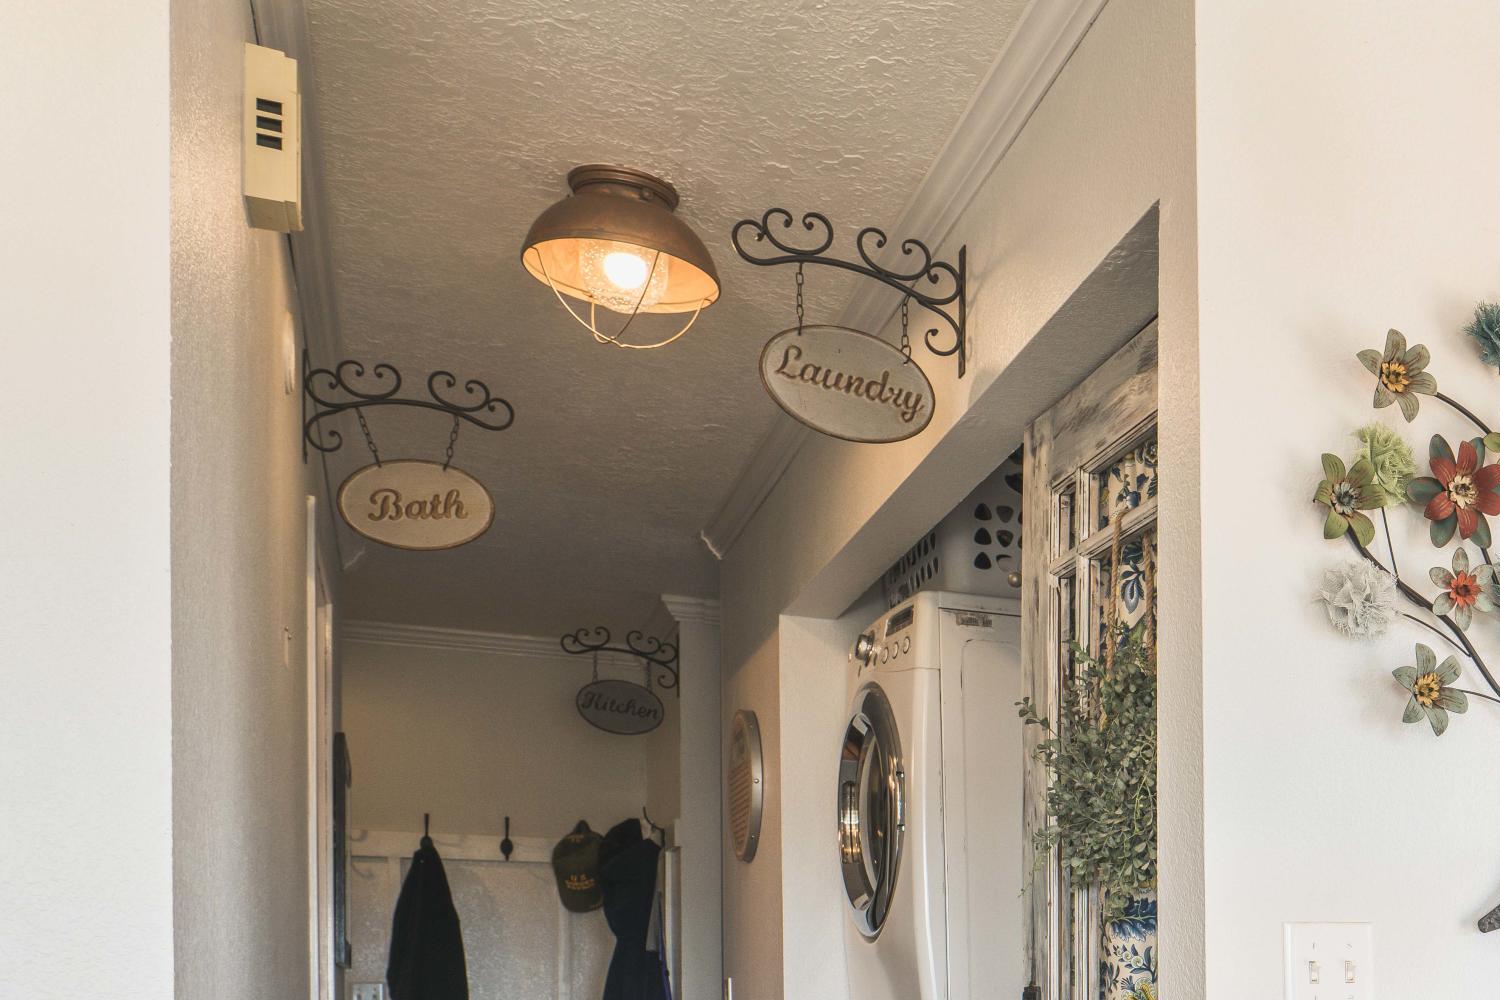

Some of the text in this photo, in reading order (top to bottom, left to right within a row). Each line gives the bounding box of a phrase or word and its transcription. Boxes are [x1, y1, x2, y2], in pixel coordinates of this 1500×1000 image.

[775, 345, 925, 423] Laundry
[368, 488, 468, 521] Bath
[581, 691, 658, 719] Kitchen
